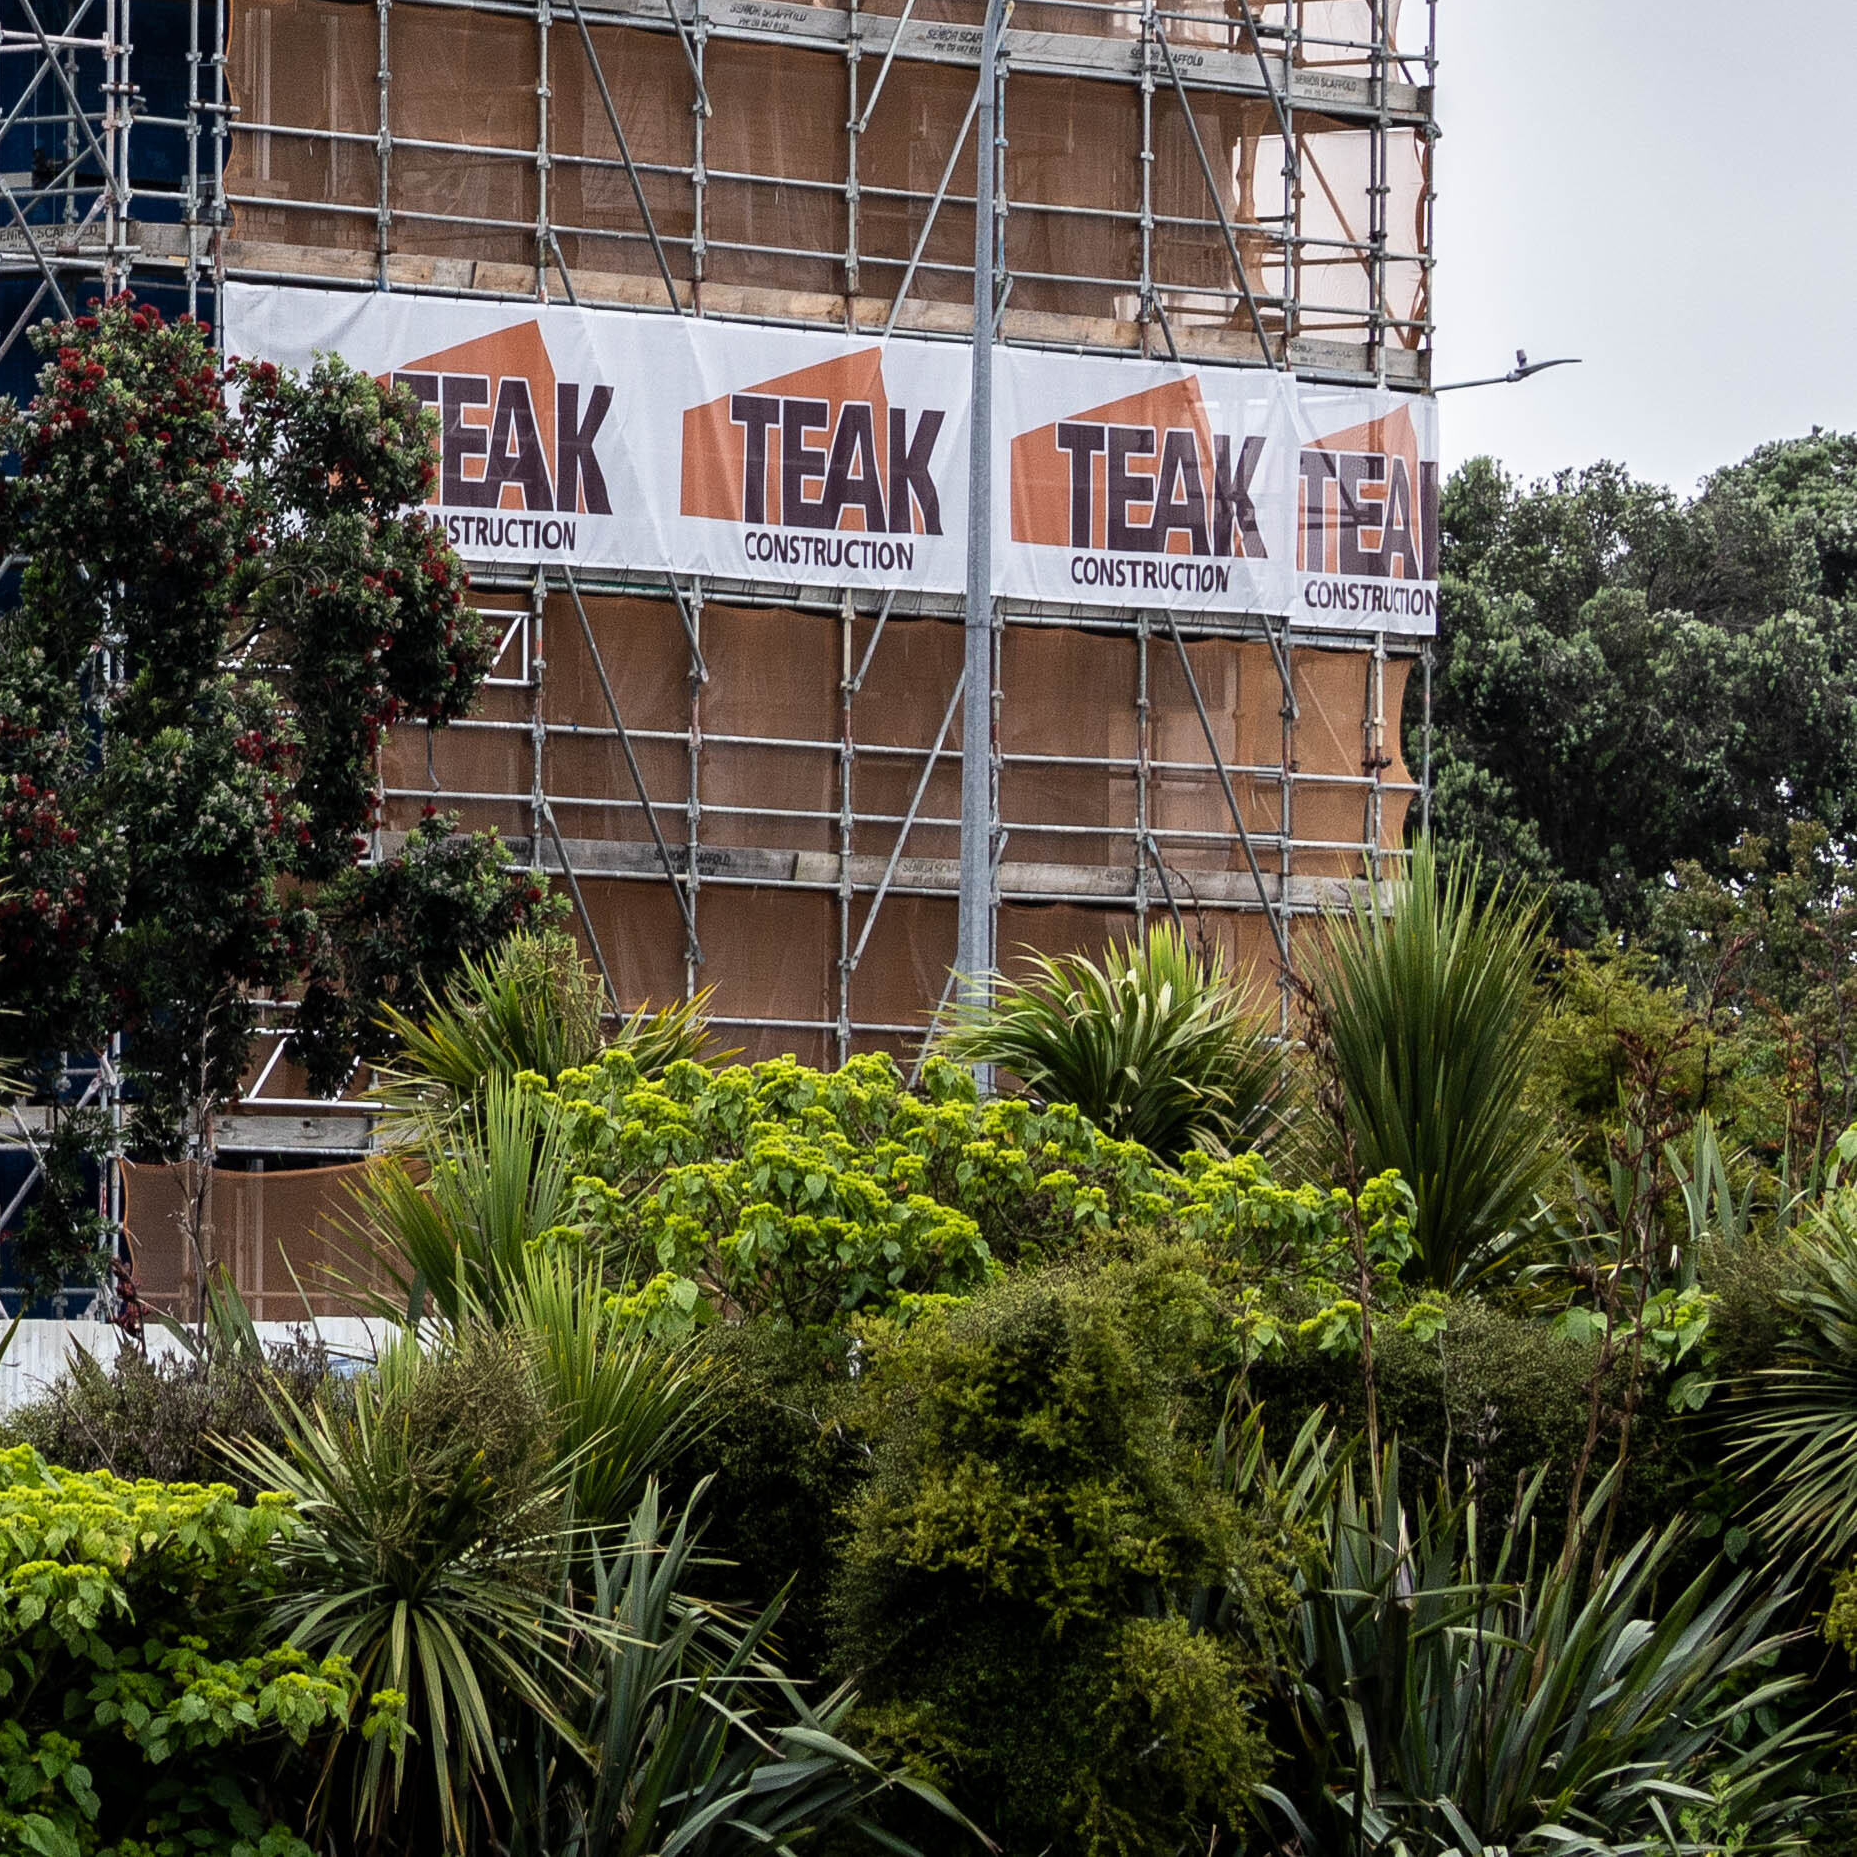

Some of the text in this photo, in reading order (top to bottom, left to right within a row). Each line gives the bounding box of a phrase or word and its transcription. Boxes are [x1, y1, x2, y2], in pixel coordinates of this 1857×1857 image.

[729, 3, 762, 17] SENIOR
[926, 28, 984, 44] SENIOR SCAF
[1161, 51, 1205, 68] AFFOLD
[731, 393, 946, 536] TEAK
[1057, 422, 1269, 559] TEAK
[403, 513, 576, 551] NSTRUCTION
[745, 531, 914, 570] CONSTRUCTION
[1071, 556, 1231, 593] CONSTRUCTION
[1304, 579, 1439, 617] CONSTRUCTION
